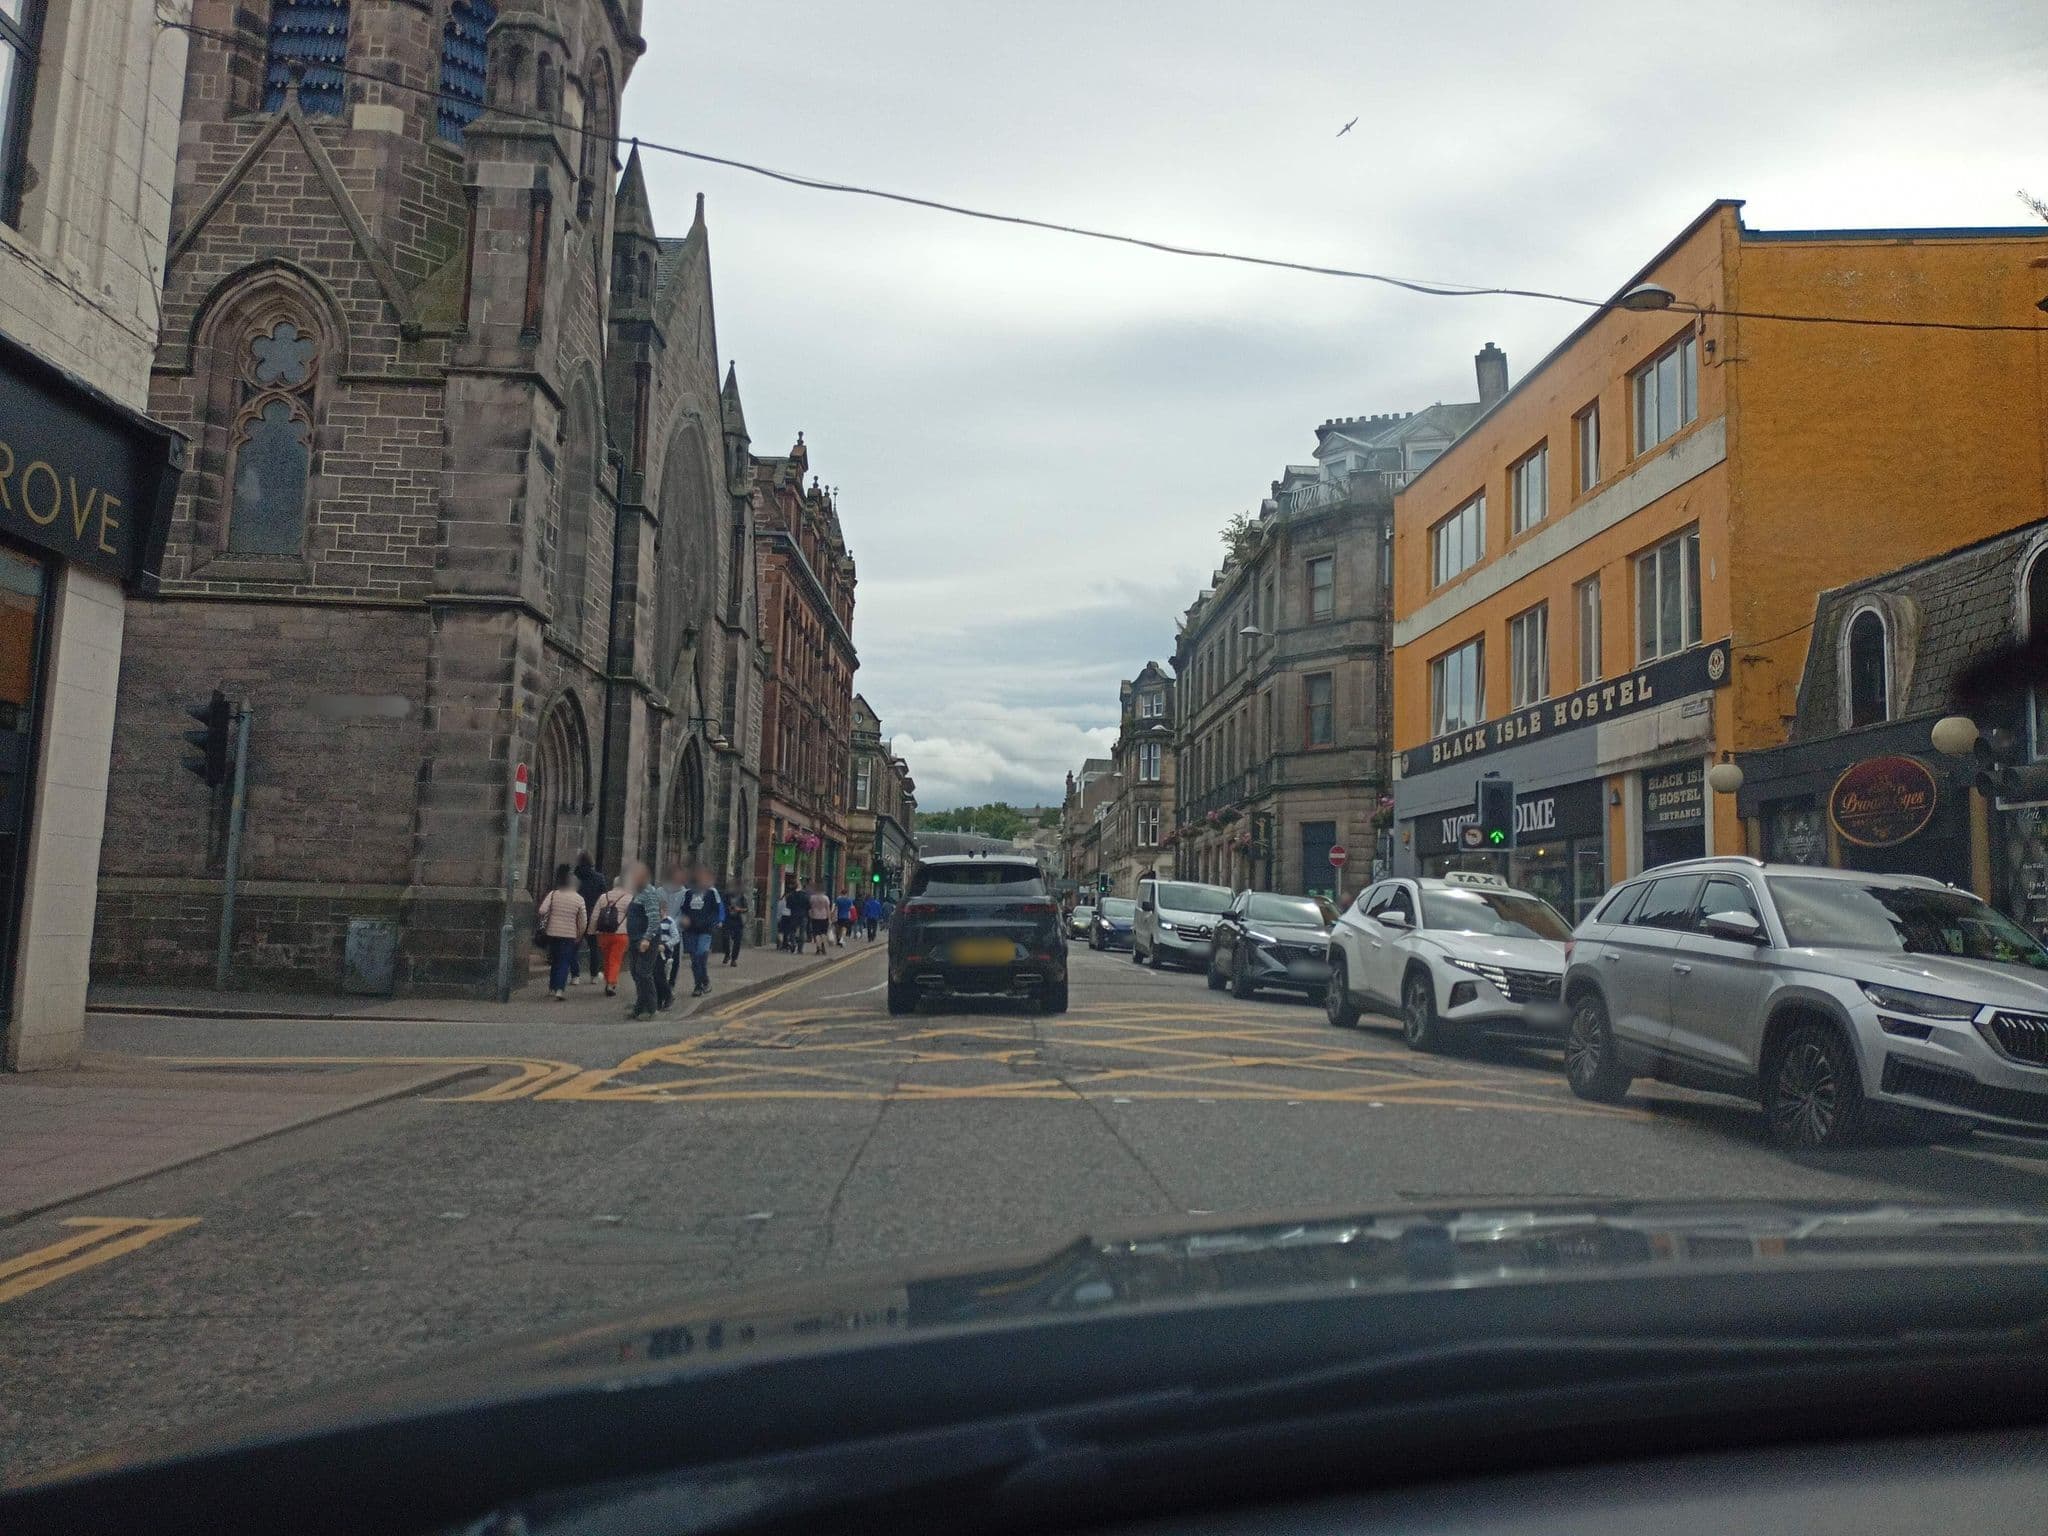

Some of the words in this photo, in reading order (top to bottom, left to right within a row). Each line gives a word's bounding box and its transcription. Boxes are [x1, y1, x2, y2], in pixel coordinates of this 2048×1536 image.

[1432, 729, 1486, 764] BLACK
[1496, 711, 1541, 744] ISLE
[1554, 675, 1653, 727] HOSTEL
[1648, 773, 1684, 790] BLACK
[1687, 769, 1705, 783] ISL
[1659, 788, 1701, 806] HOSTEL
[1659, 807, 1702, 821] ENTRANCE
